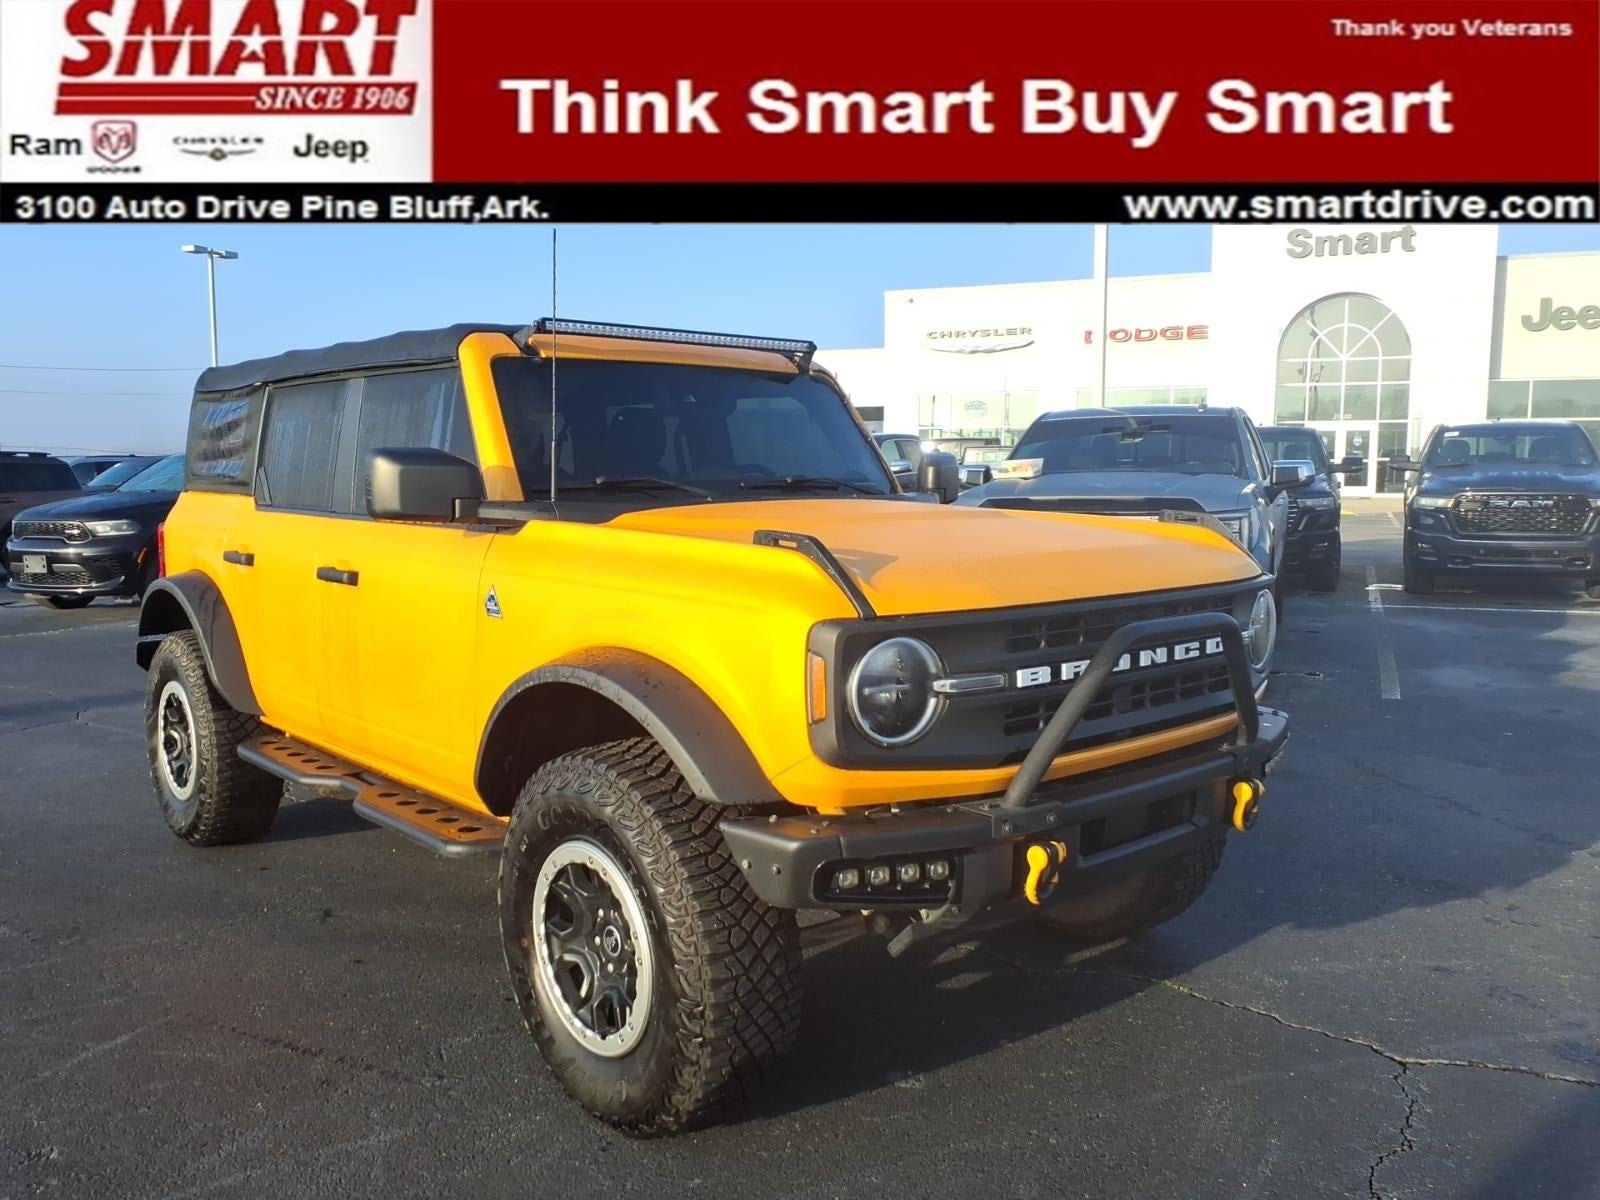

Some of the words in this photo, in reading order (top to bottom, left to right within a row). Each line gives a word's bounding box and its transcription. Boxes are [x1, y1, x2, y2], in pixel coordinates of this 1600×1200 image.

[1286, 226, 1417, 259] Smart
[926, 326, 1033, 340] CHRYSLER
[1487, 500, 1554, 508] RAM
